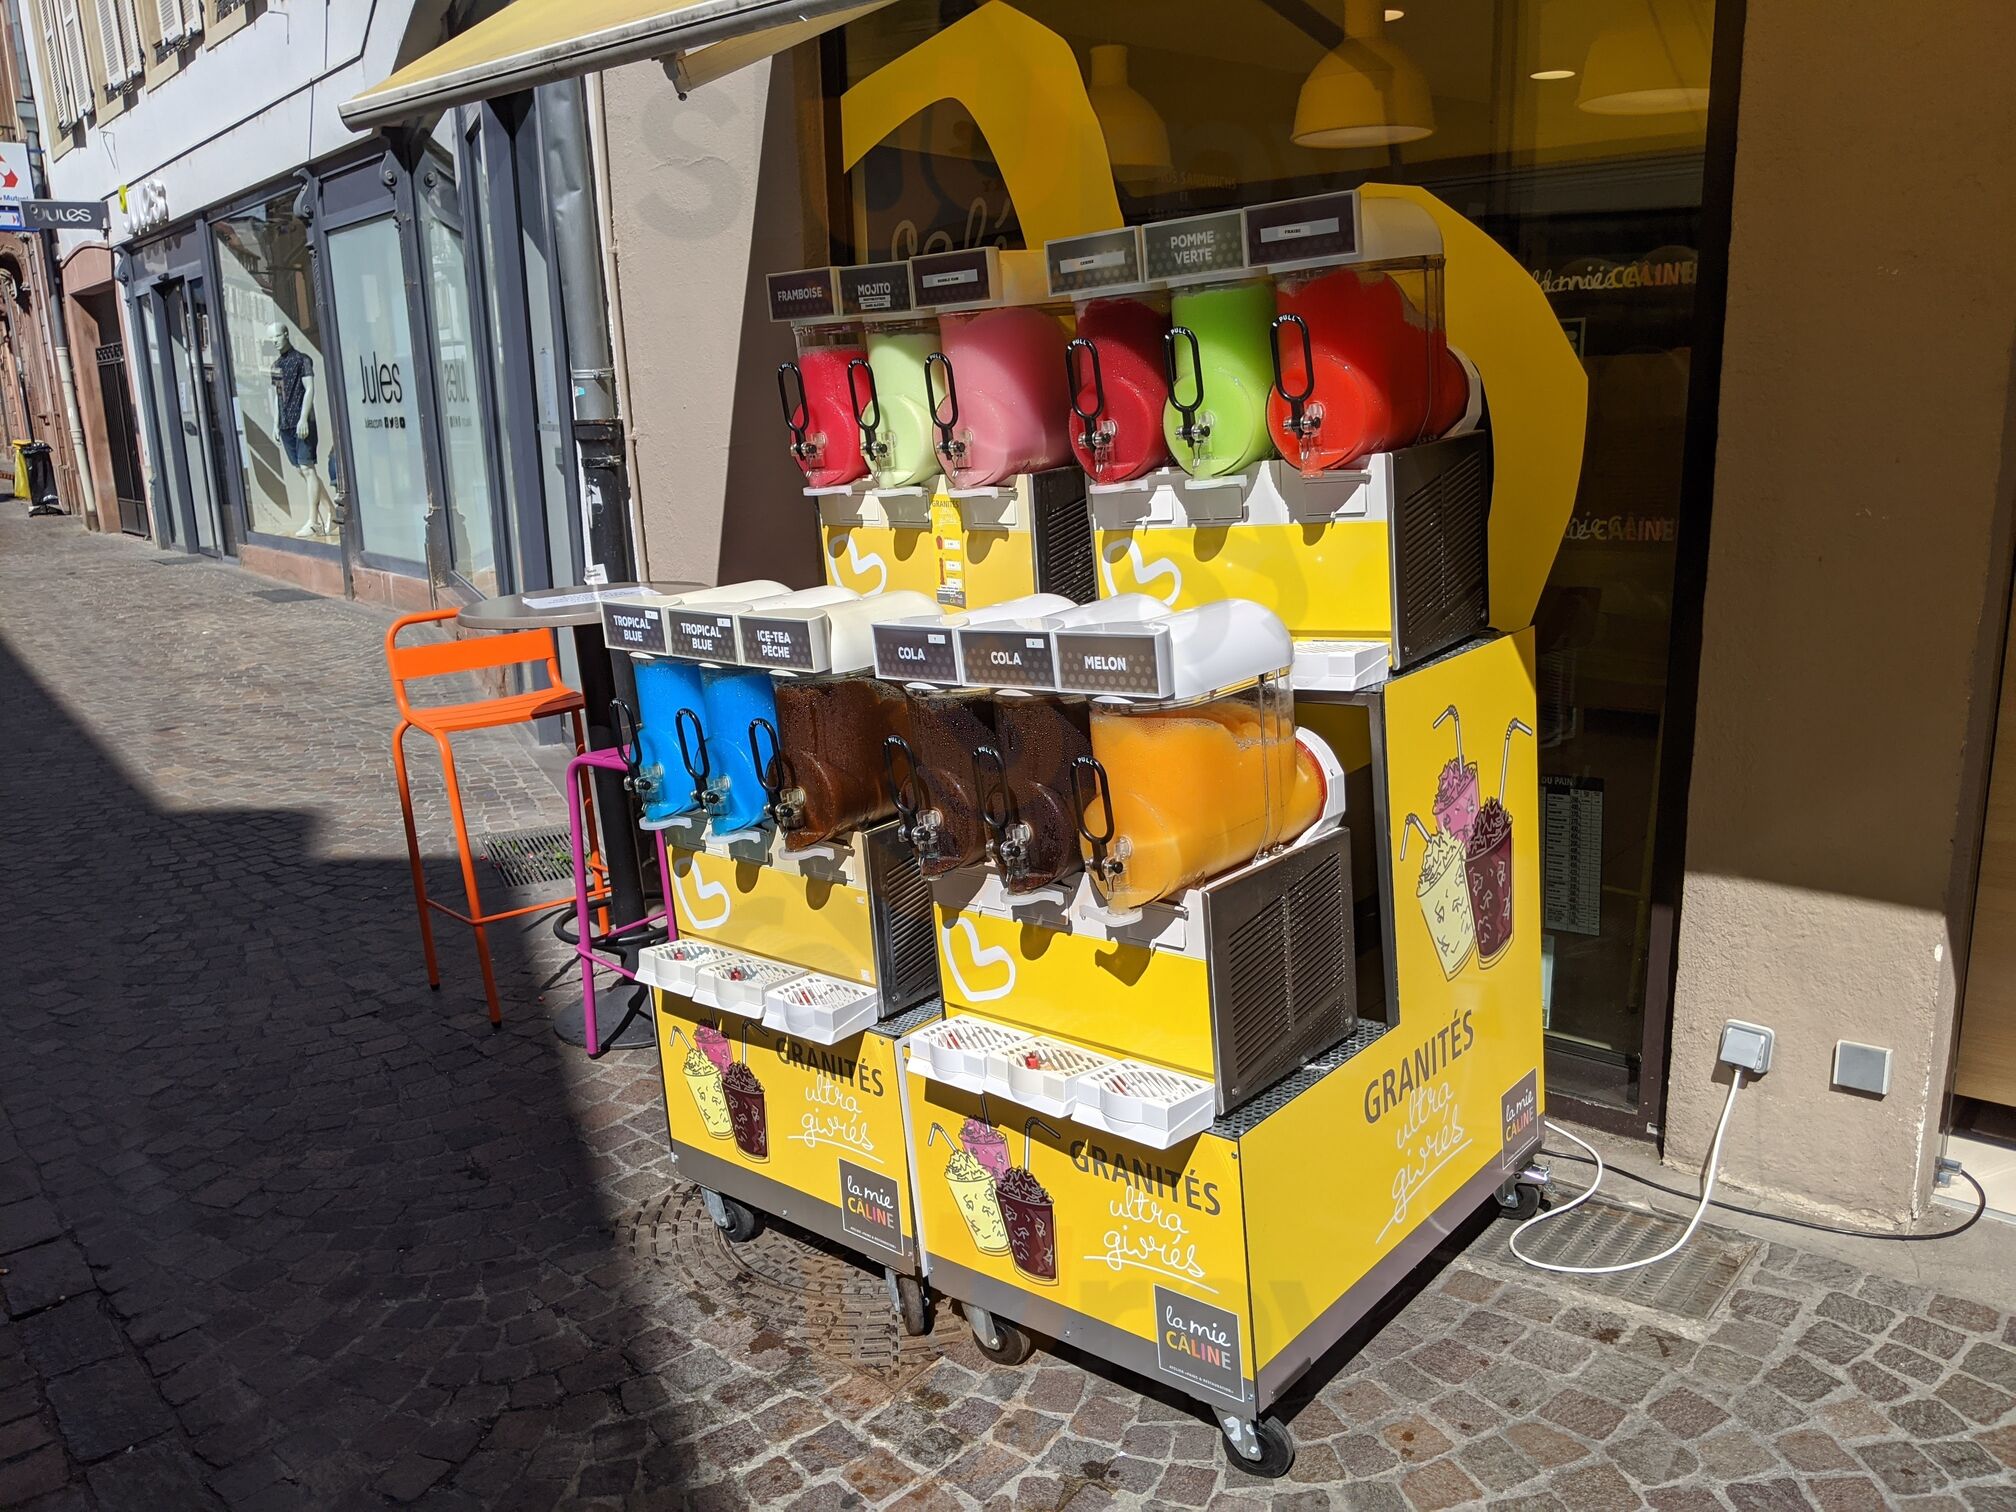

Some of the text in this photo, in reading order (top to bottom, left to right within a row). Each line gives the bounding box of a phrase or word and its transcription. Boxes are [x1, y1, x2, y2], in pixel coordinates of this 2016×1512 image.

[1170, 230, 1215, 249] POMME
[1174, 249, 1213, 265] VERTE
[777, 286, 823, 302] FRAMBOISE
[857, 282, 891, 296] MOJITO
[1278, 314, 1296, 323] PULL
[1170, 327, 1187, 335] PULL
[1071, 337, 1087, 346] PULL
[929, 353, 942, 361] PULL
[360, 351, 403, 404] Jules
[613, 614, 651, 630] TROPICAL
[680, 622, 722, 638] TROPICAL
[623, 629, 643, 642] BLUE
[756, 630, 792, 644] ICE-TEA
[692, 637, 713, 651] BLUE
[761, 641, 791, 658] PÊCHE
[898, 646, 926, 661] COLA
[990, 651, 1022, 666] COLA
[1084, 655, 1127, 671] MELON
[887, 737, 901, 745] PULL
[978, 746, 993, 755] PULL
[1077, 757, 1094, 766] PULL
[775, 1036, 885, 1097] GRANITÉS
[1363, 1008, 1475, 1124] GRANITÉS
[805, 1073, 863, 1114] ultra
[1505, 1088, 1534, 1123] la mie
[1396, 1081, 1455, 1149] ultra
[801, 1108, 875, 1149] givrés
[1505, 1105, 1534, 1142] CÂLINE
[1391, 1103, 1465, 1224] givrés
[1070, 1139, 1222, 1216] GRANITÉS
[847, 1175, 894, 1210] la mie
[847, 1196, 895, 1230] CÂLINE
[1110, 1185, 1189, 1234] ultra
[1103, 1225, 1206, 1278] givrés
[1166, 1305, 1231, 1347] la mie
[1166, 1330, 1232, 1371] CÂLINE
